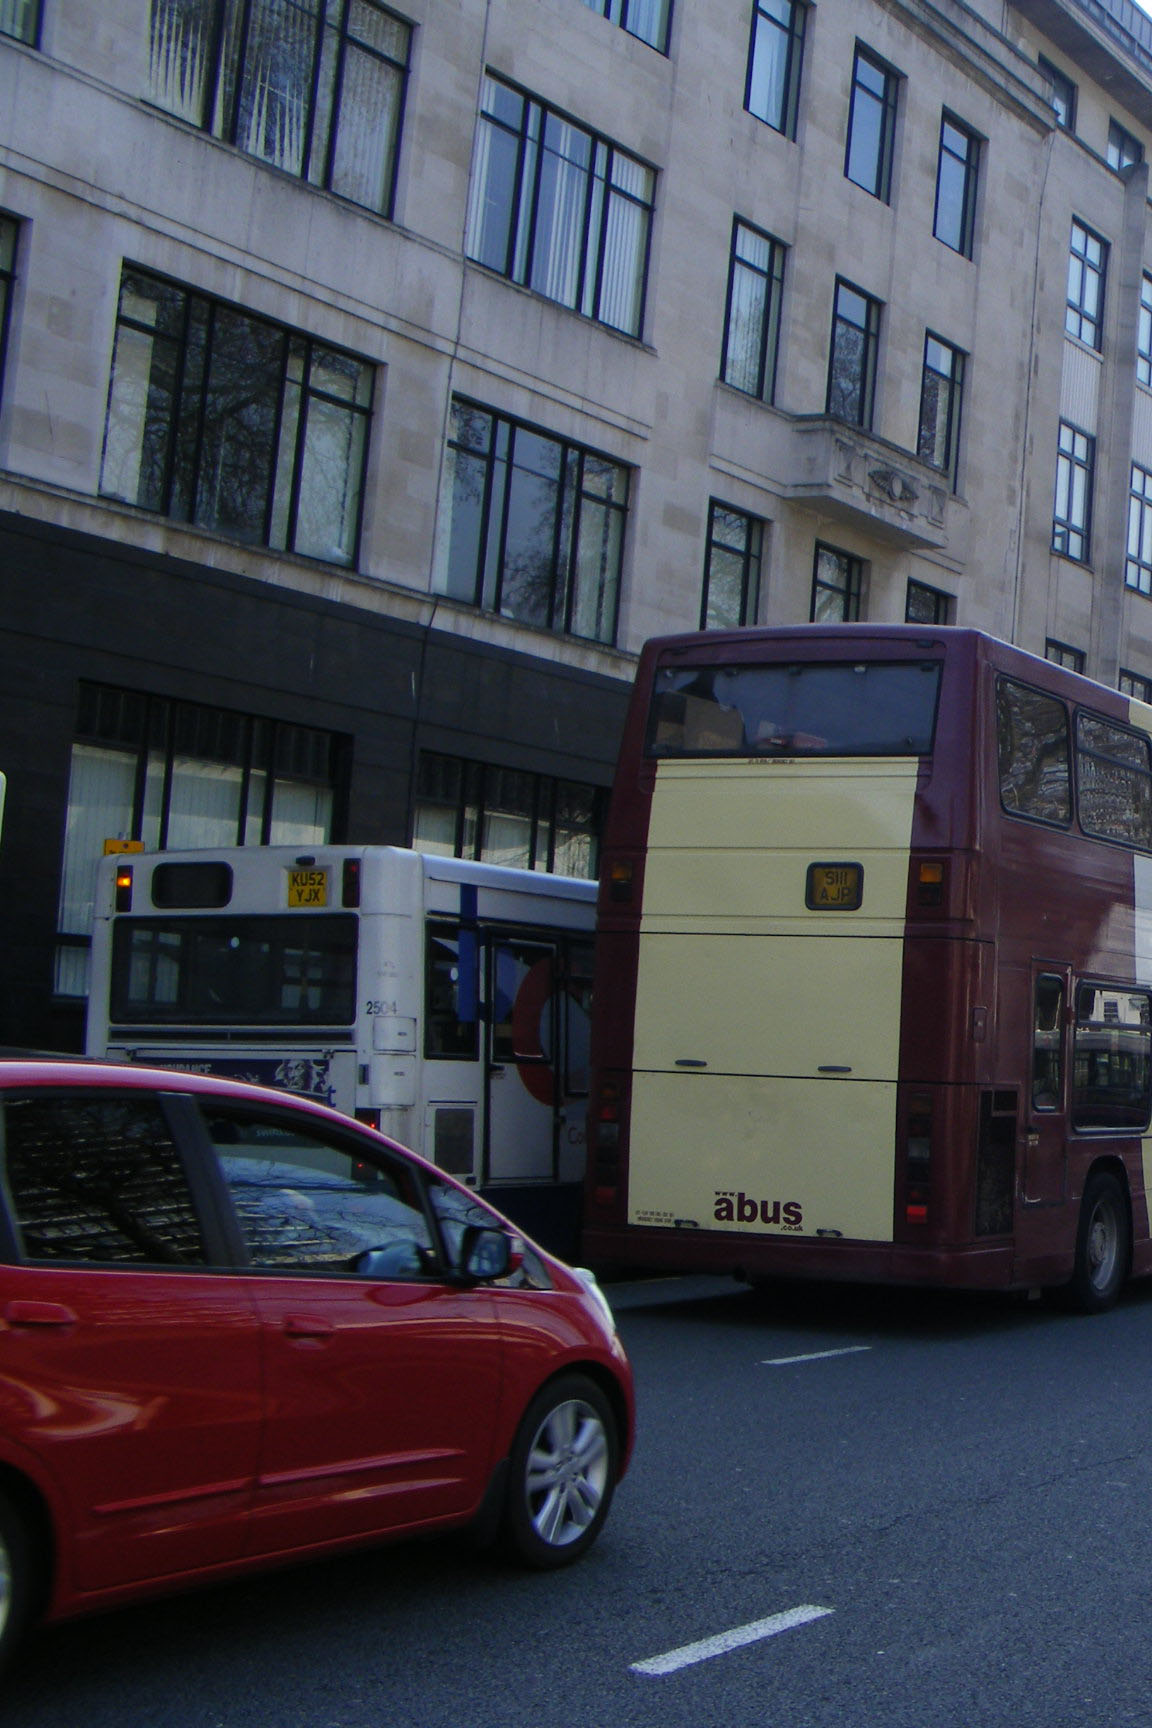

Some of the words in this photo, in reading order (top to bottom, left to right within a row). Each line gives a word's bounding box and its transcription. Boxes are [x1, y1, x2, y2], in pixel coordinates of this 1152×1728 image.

[291, 872, 324, 886] KU52
[296, 890, 320, 902] YJX
[714, 1192, 803, 1226] abus
